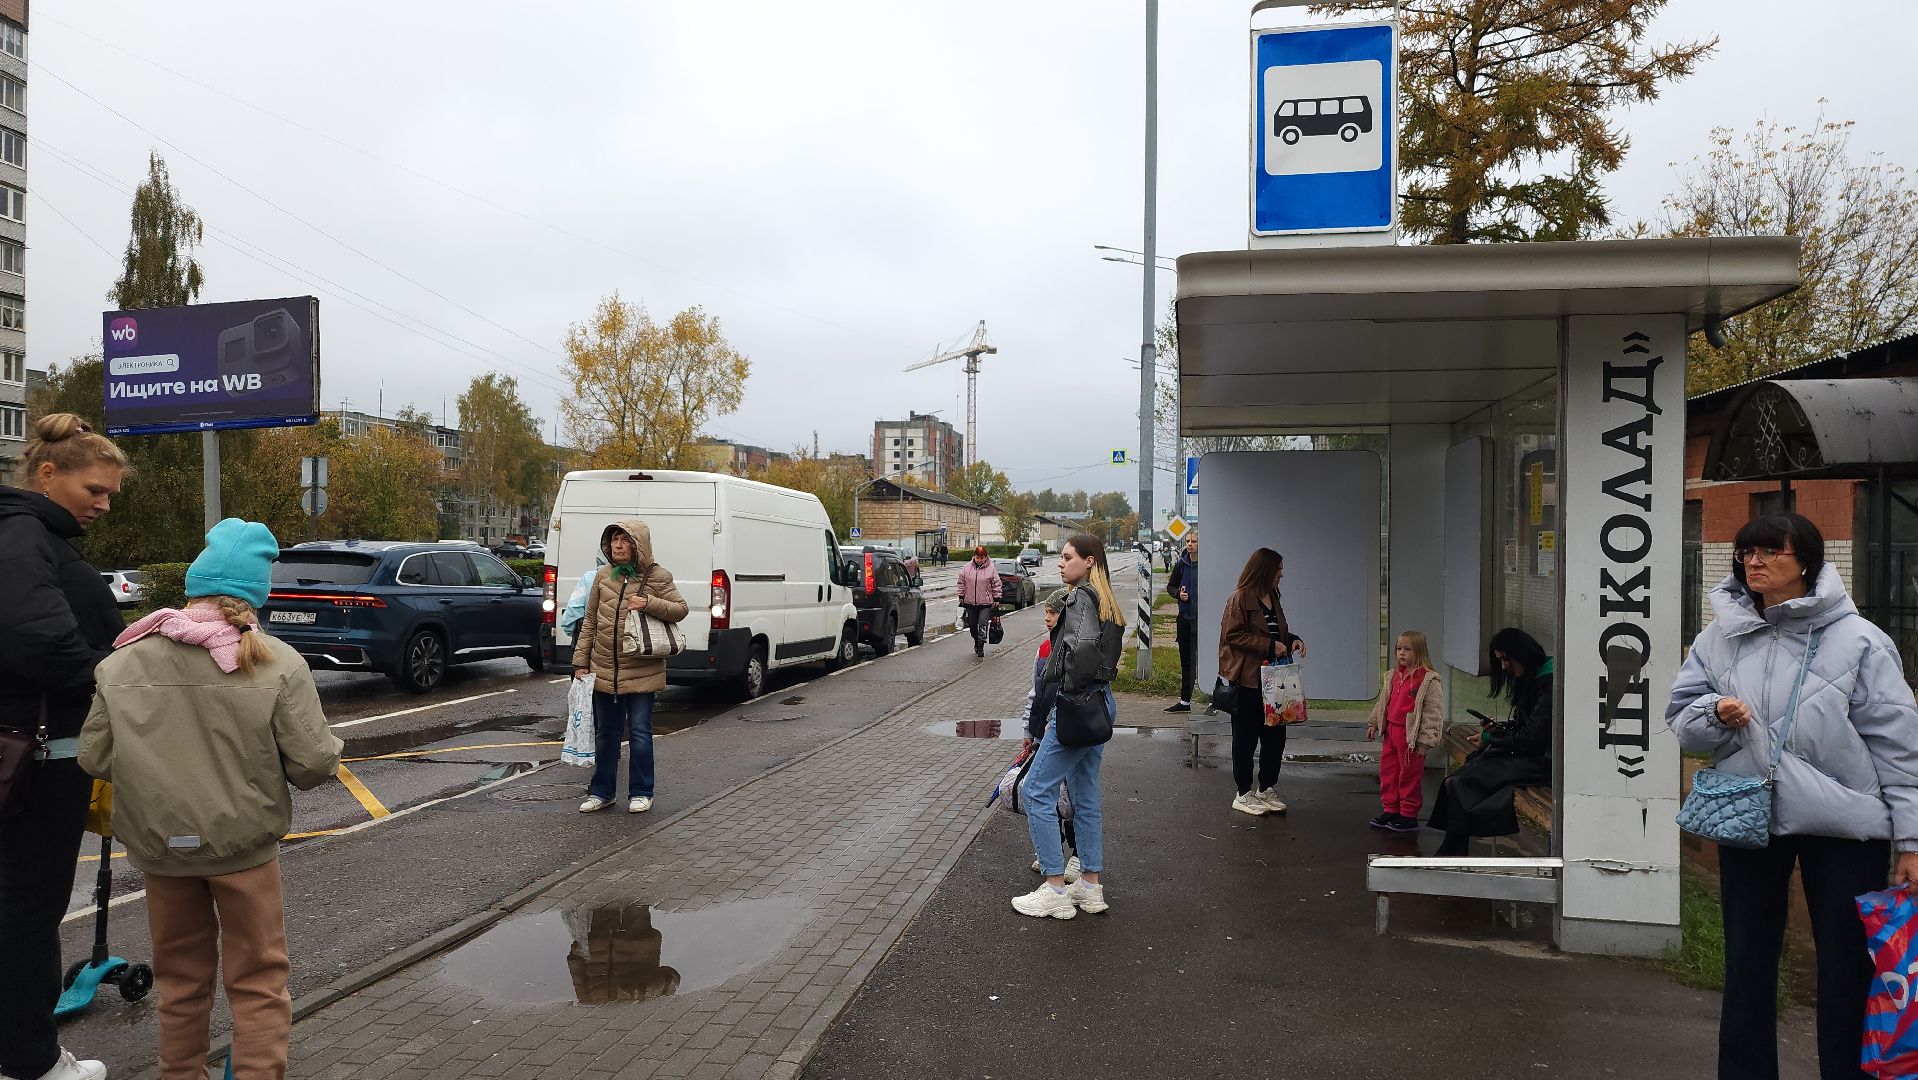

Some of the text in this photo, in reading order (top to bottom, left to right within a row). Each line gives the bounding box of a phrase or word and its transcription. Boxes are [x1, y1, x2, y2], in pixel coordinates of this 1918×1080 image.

[111, 324, 136, 341] wb
[117, 360, 163, 370] ЭЛЕКТРОНИКА
[110, 373, 262, 399] Ищите на WB
